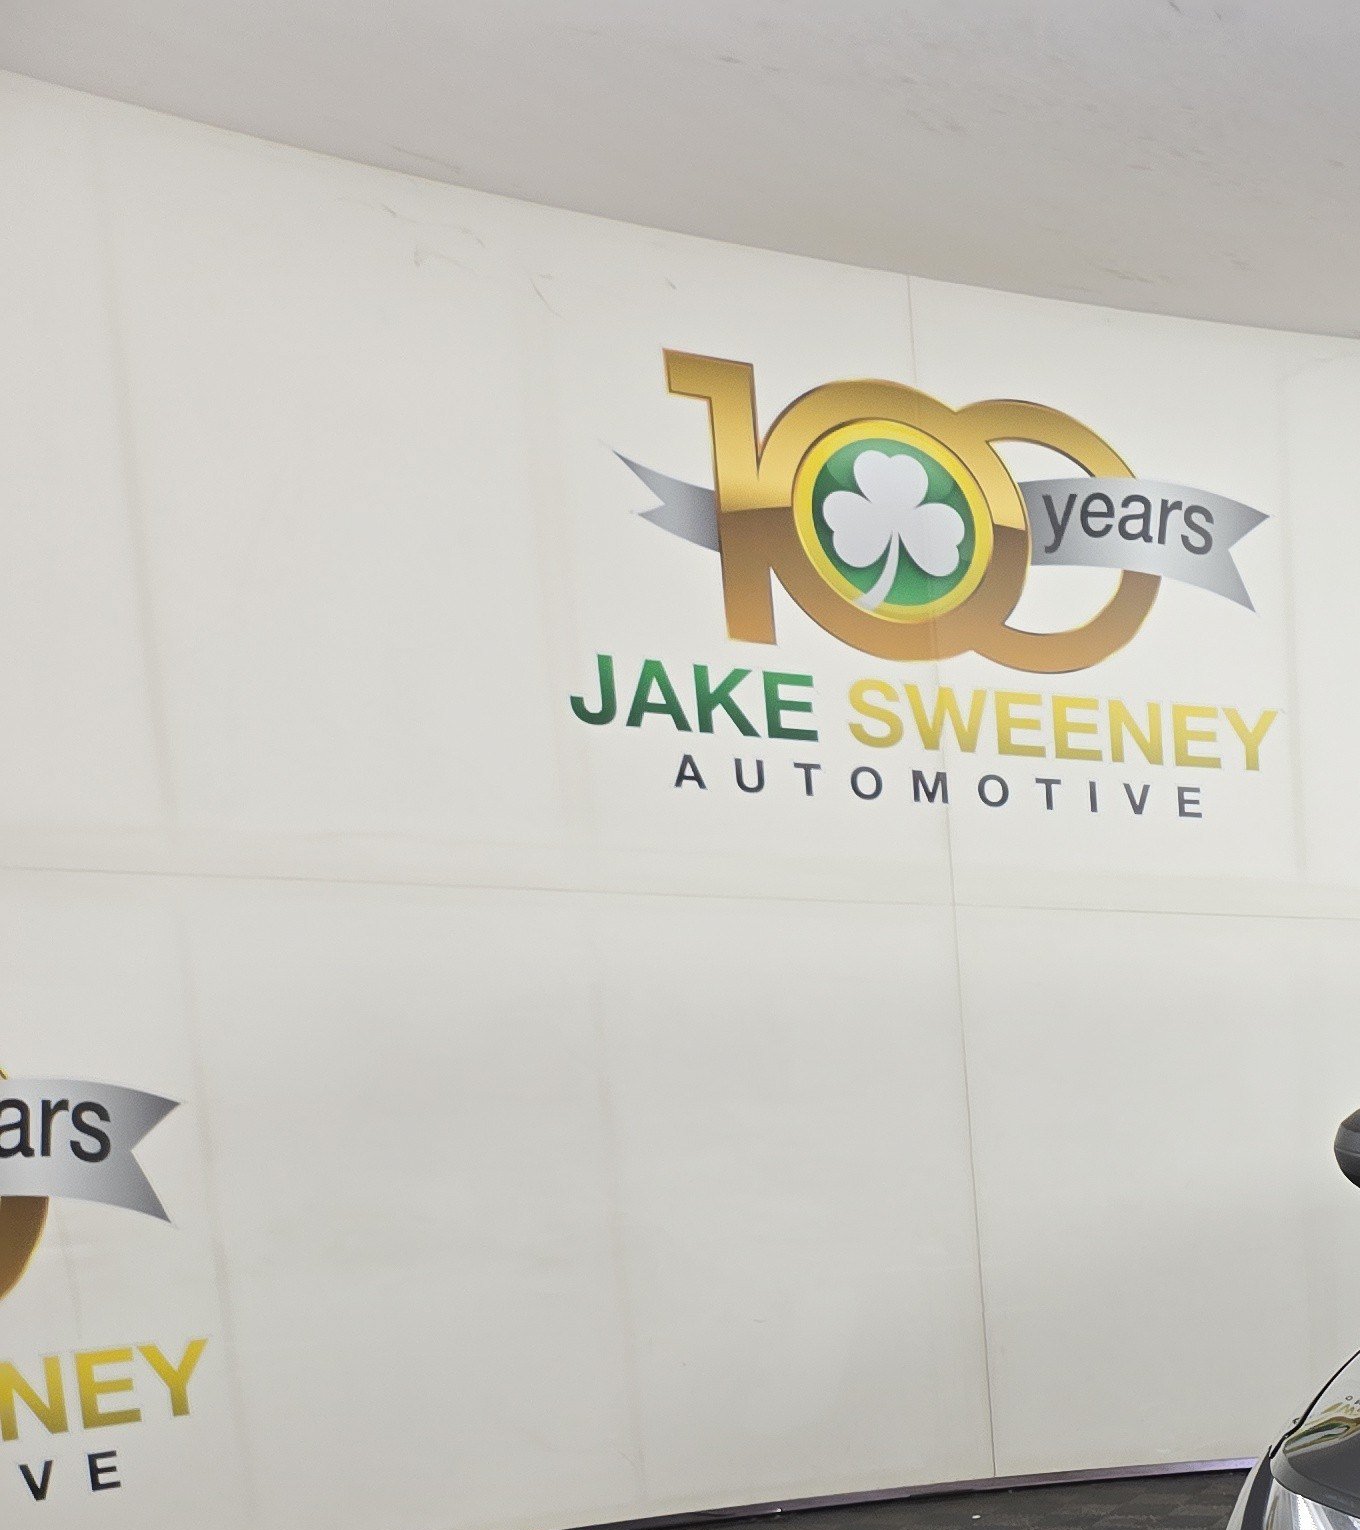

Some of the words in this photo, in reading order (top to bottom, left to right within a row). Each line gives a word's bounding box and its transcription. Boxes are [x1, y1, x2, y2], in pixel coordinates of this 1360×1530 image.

[1041, 492, 1215, 556] years
[570, 653, 819, 742] JAKE
[849, 678, 1278, 771] SWEENEY
[674, 754, 1203, 818] AUTOMOTIVE
